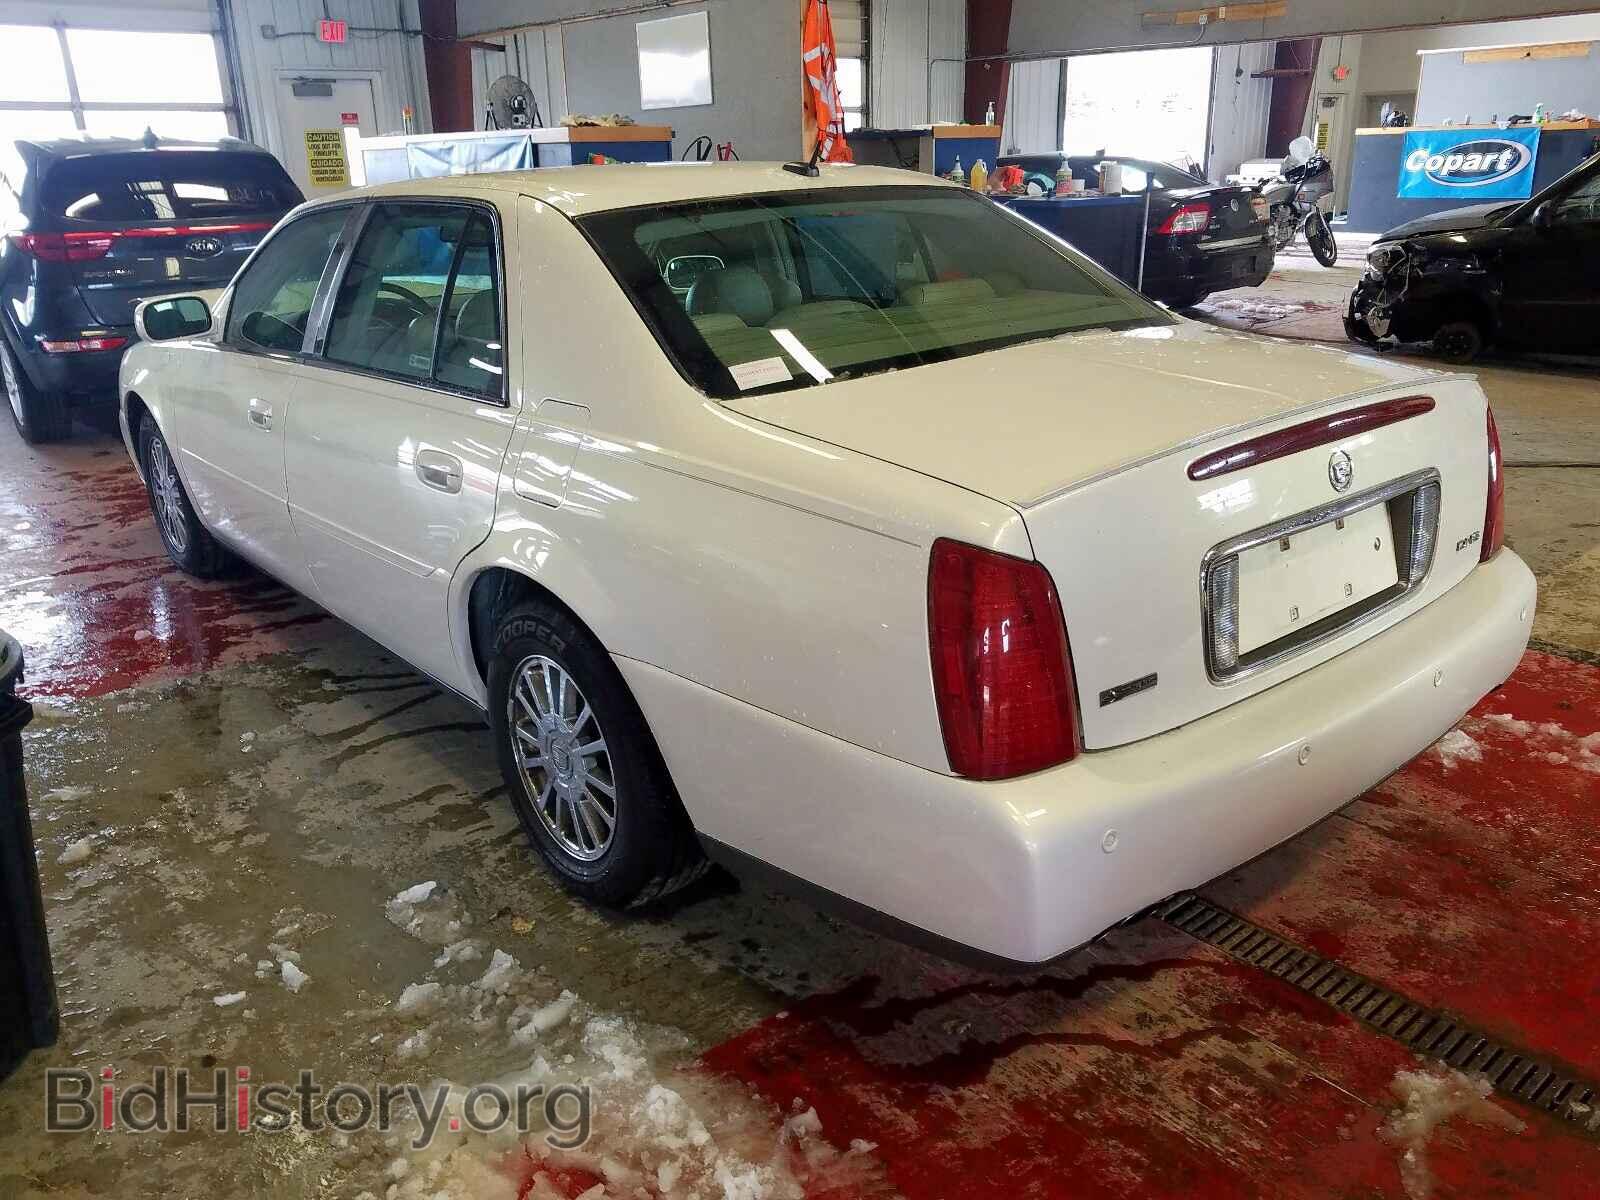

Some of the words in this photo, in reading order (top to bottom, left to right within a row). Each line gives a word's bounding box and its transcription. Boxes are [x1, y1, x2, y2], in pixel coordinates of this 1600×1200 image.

[321, 21, 345, 43] EXIT
[307, 133, 340, 142] CAUTION
[312, 159, 344, 168] CUIDADO
[1405, 148, 1513, 177] Copart
[190, 241, 213, 251] KIA
[496, 621, 566, 653] COOPER
